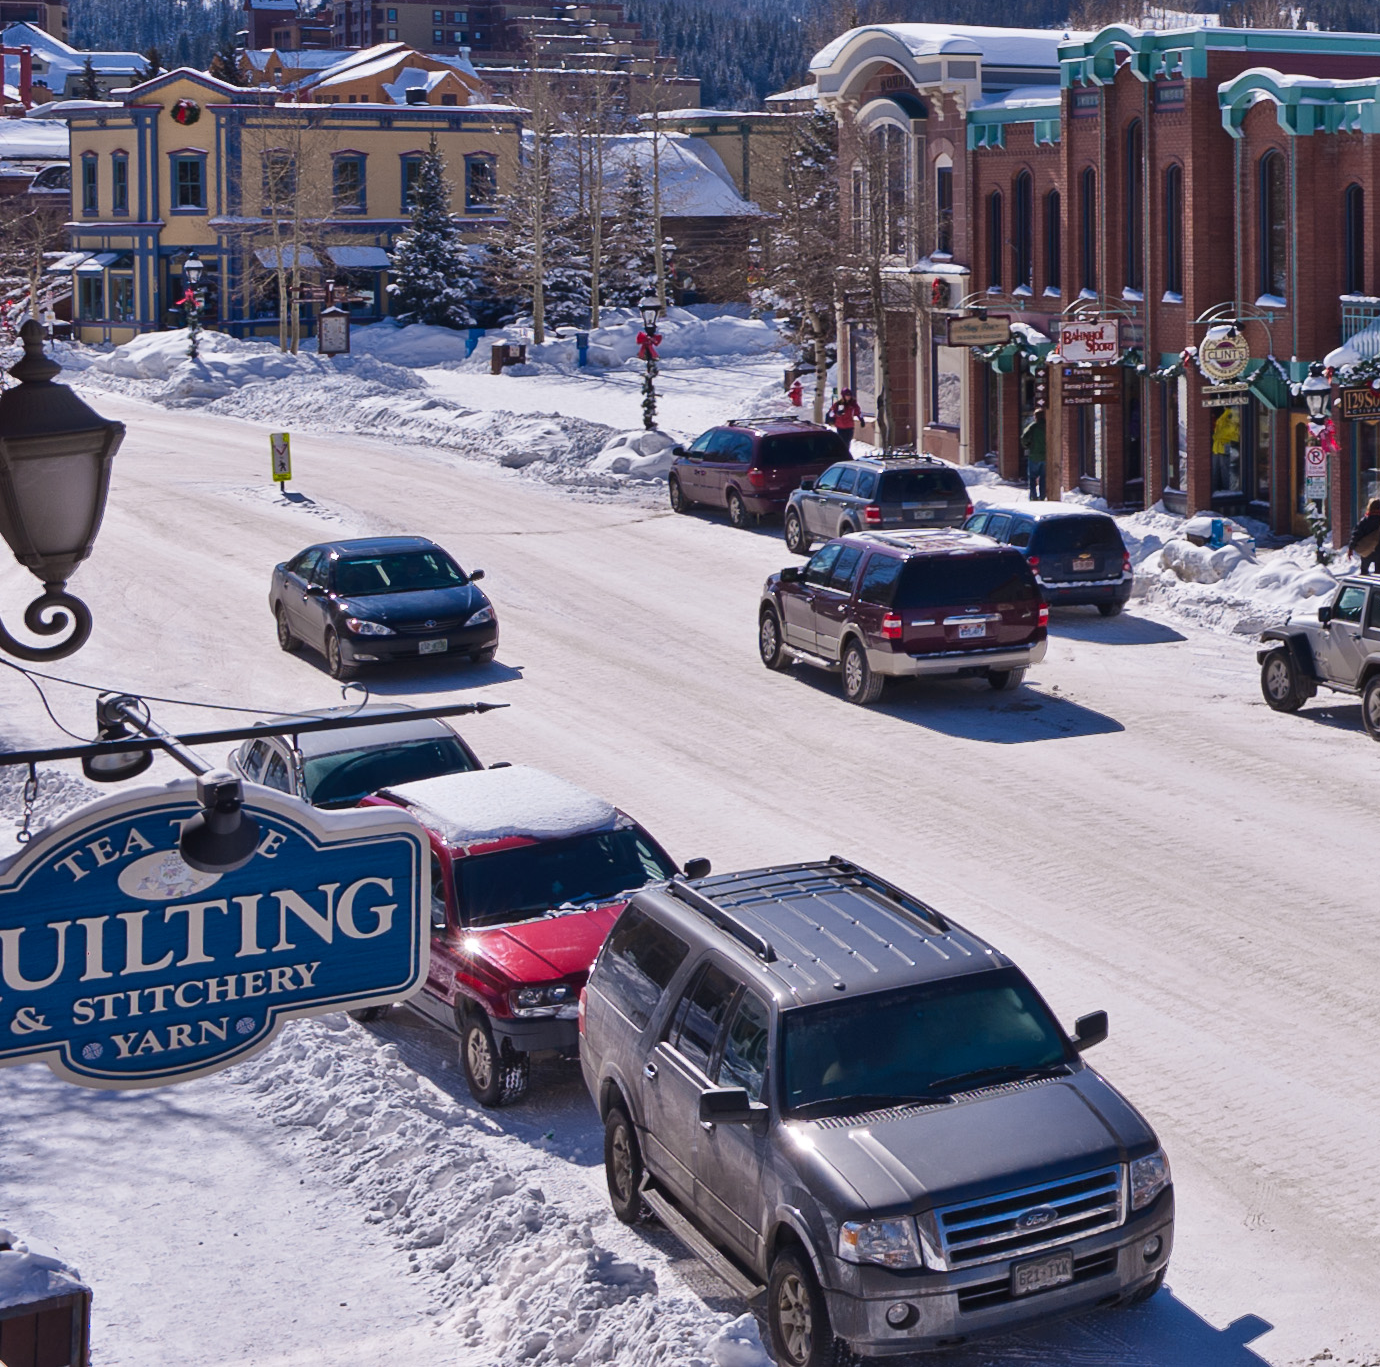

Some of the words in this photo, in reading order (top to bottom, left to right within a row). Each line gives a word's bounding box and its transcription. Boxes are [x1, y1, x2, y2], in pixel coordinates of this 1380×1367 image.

[54, 827, 155, 882] TEA
[0, 877, 398, 991] UILTING
[10, 1007, 53, 1035] &
[73, 962, 322, 1025] STITCHERY
[110, 1017, 230, 1060] YARN
[1026, 1213, 1049, 1226] Ford
